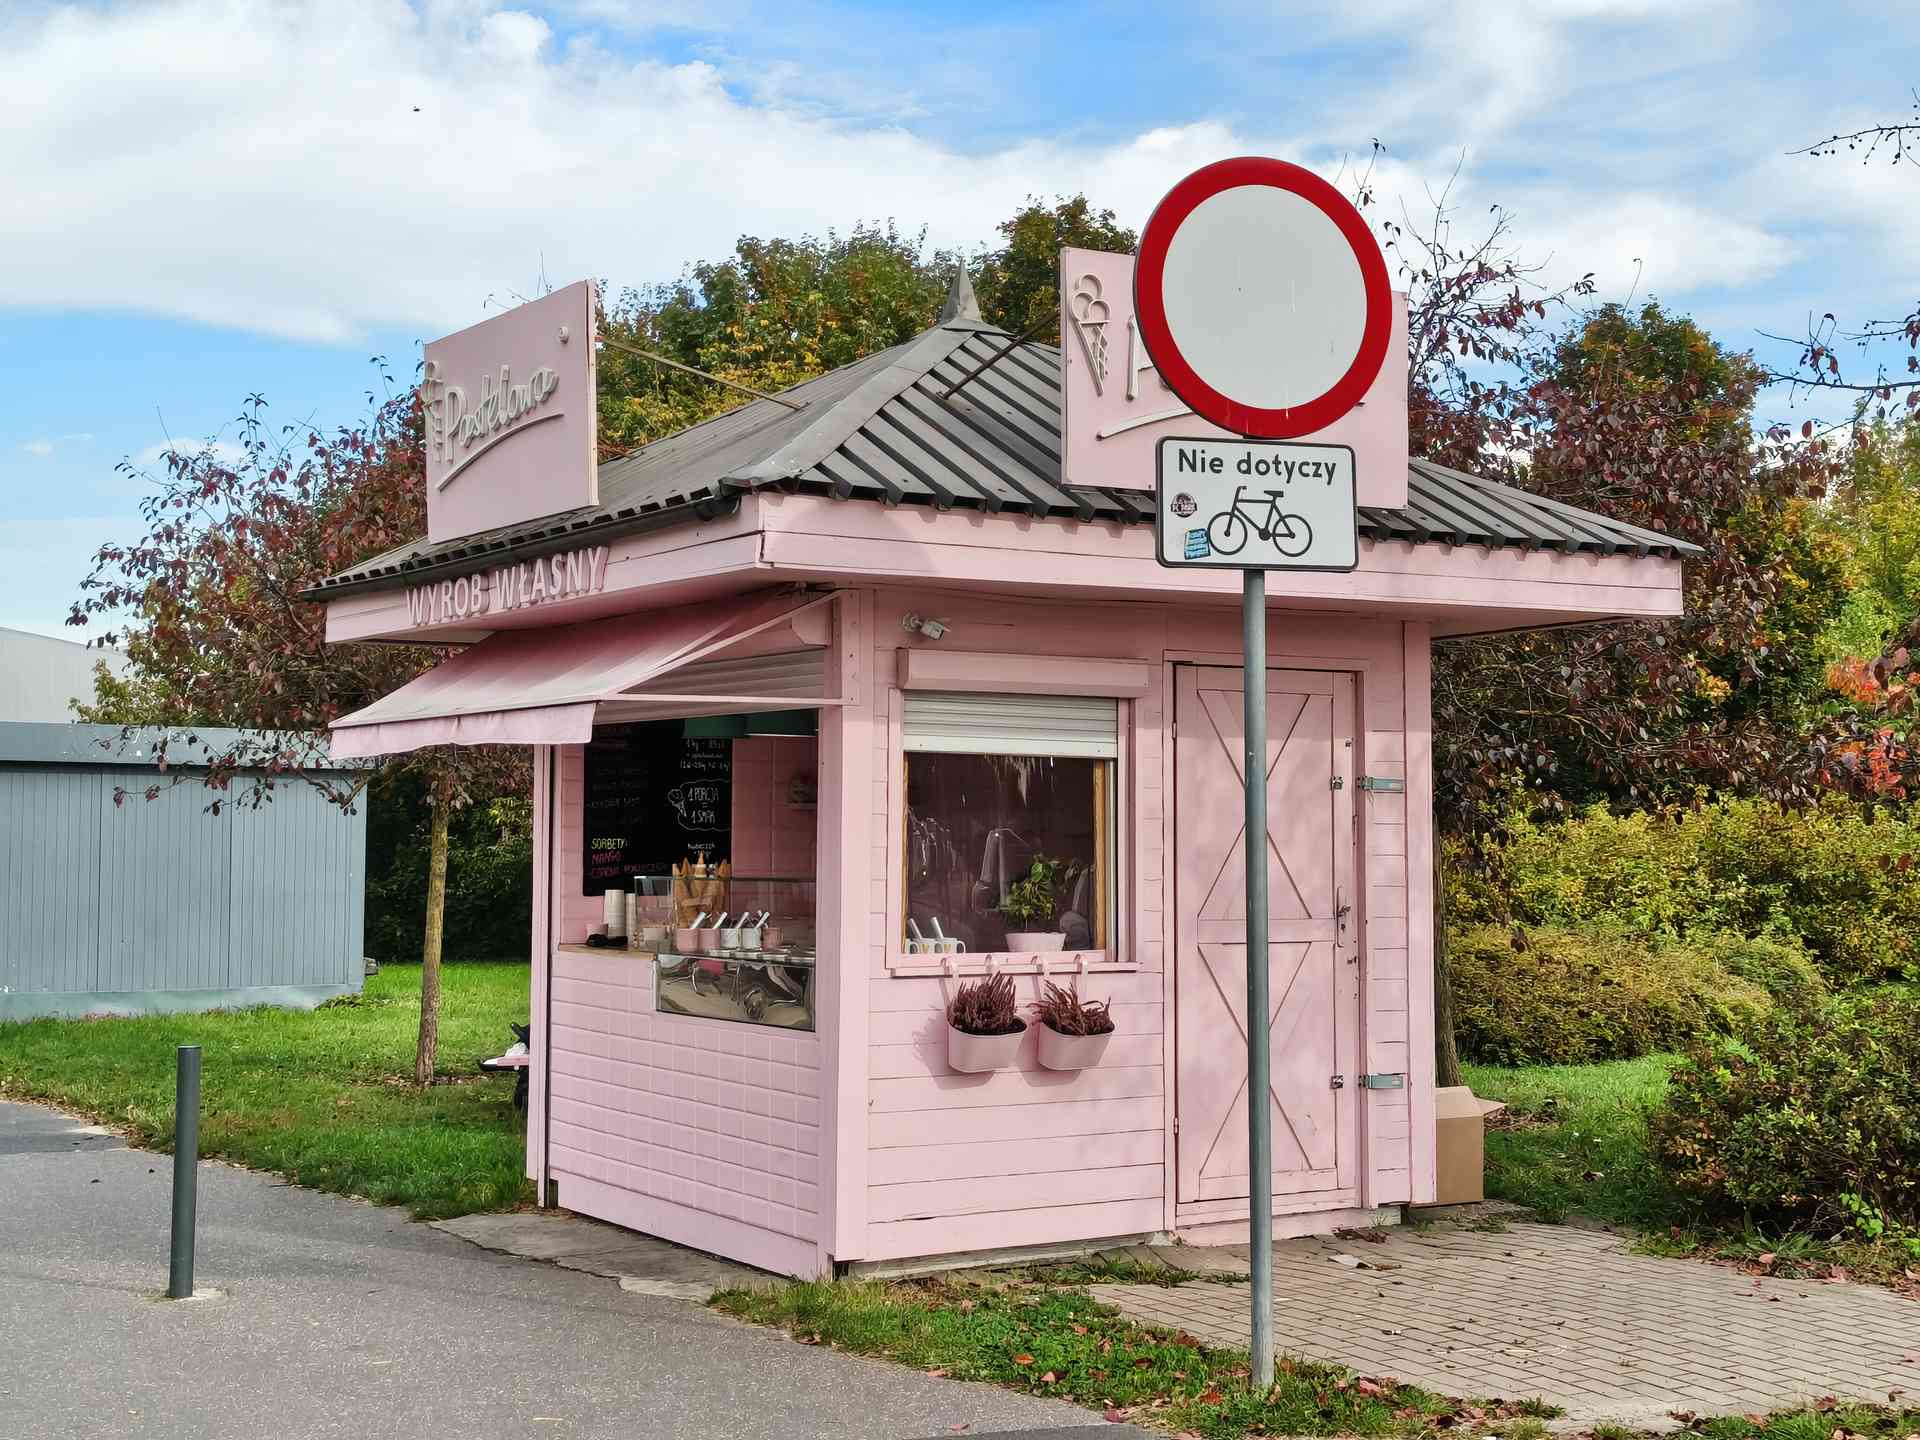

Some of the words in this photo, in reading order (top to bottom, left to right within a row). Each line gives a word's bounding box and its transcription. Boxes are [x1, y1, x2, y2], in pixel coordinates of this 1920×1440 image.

[445, 364, 559, 465] Pastelowa
[1178, 448, 1224, 474] Nie
[1236, 451, 1337, 486] dotyczy
[495, 545, 606, 609] WŁASNY
